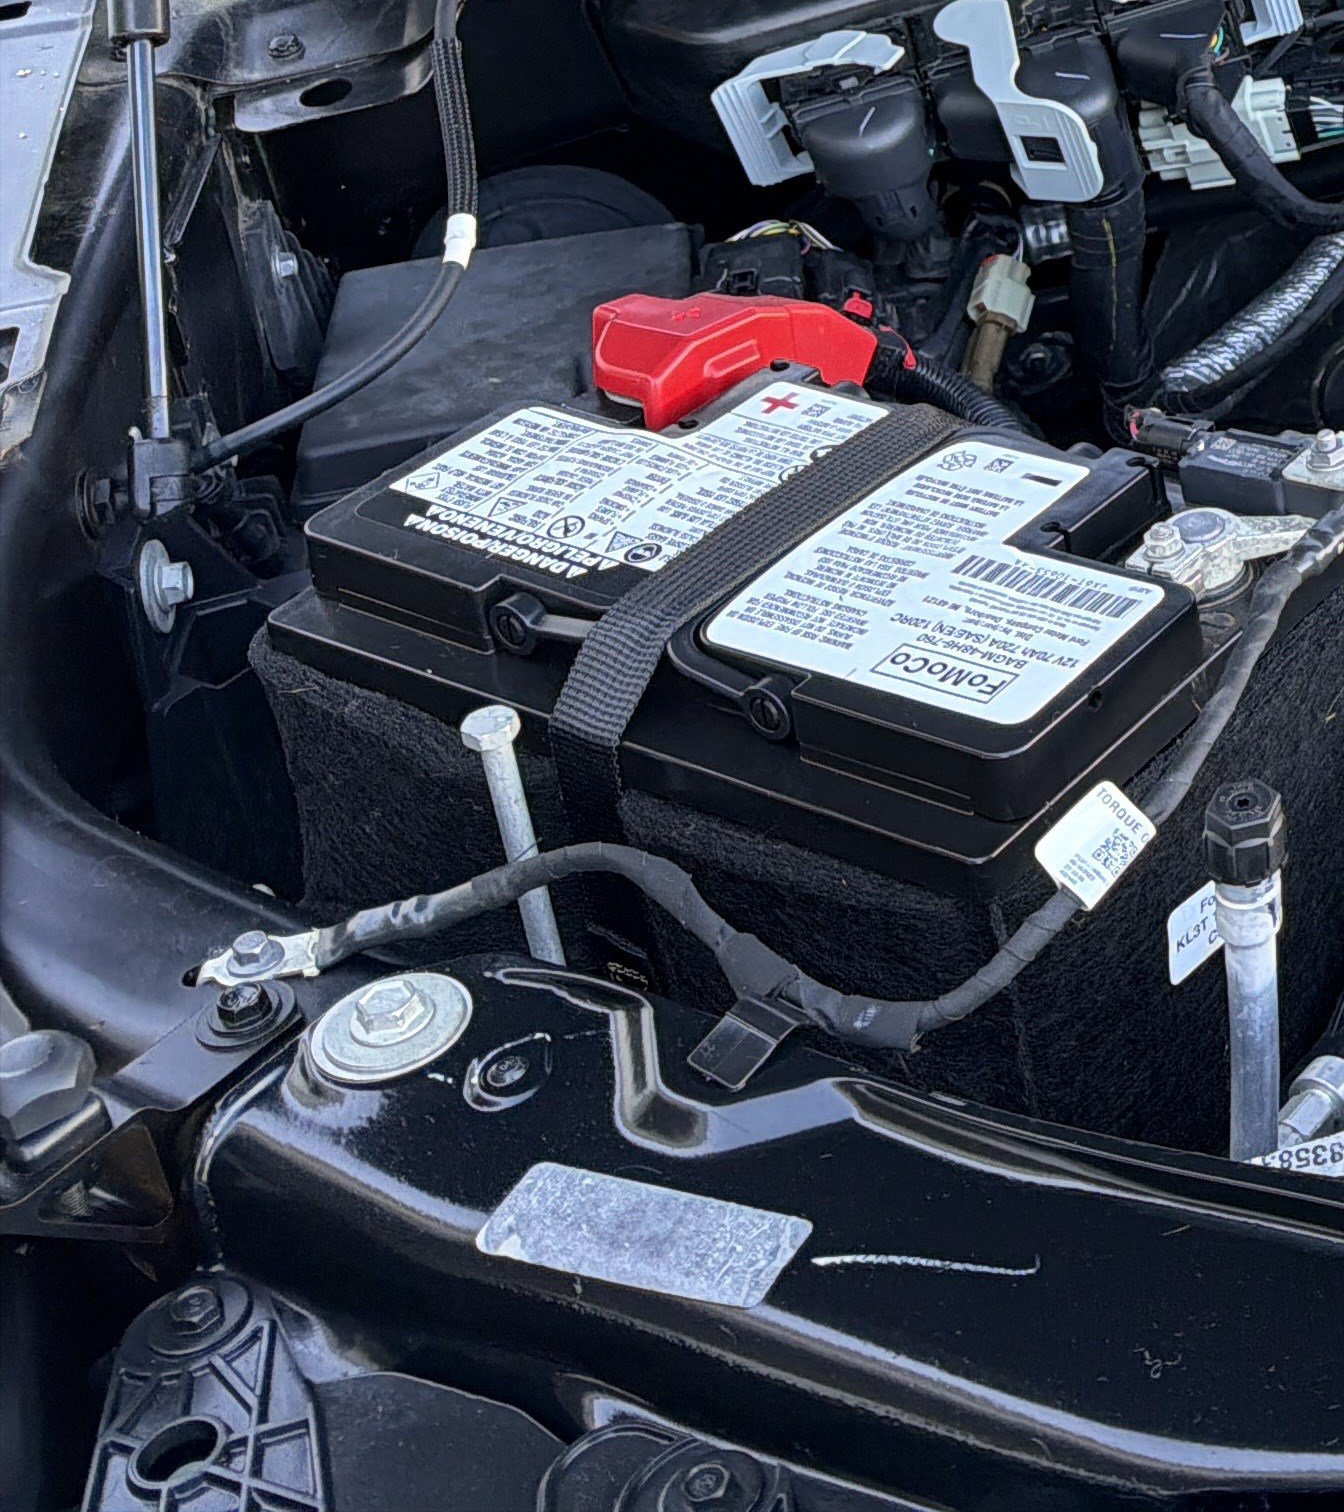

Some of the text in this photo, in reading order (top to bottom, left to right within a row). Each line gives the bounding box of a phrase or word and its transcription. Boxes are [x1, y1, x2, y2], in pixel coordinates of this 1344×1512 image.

[988, 637, 1020, 653] 720A
[1021, 647, 1054, 662] 70Ah
[890, 652, 1005, 694] FoMoCo
[1051, 656, 1078, 668] 12V
[1096, 787, 1143, 834] TORQUE
[1176, 917, 1209, 953] KL3T
